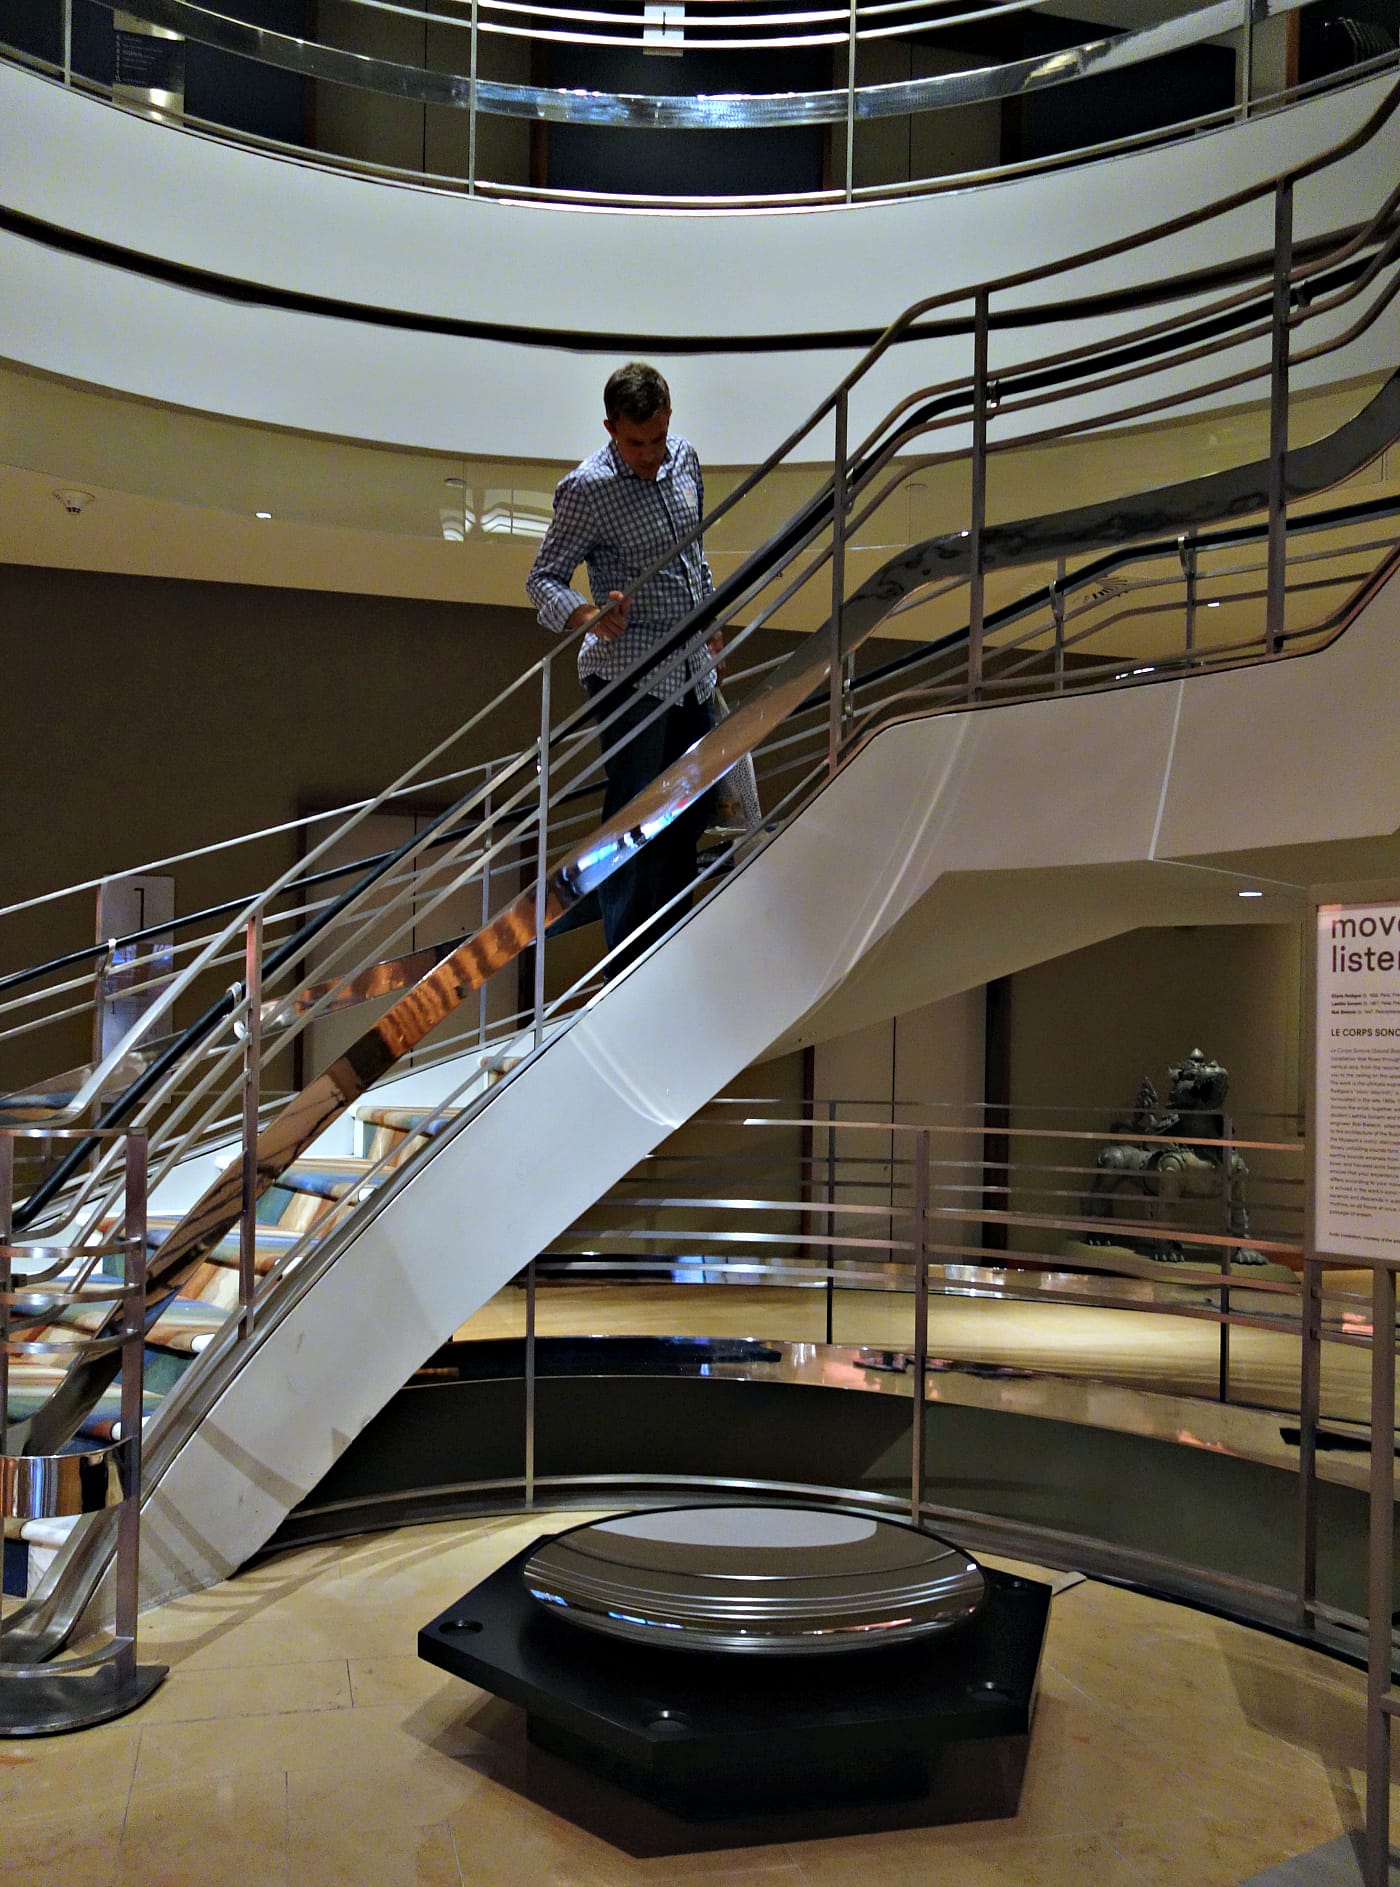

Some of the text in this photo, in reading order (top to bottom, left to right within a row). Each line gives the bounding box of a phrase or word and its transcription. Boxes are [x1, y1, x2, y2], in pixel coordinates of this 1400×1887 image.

[1331, 915, 1400, 939] mov
[1332, 945, 1400, 973] liste
[1331, 1028, 1341, 1037] LE
[1342, 1028, 1373, 1037] CORPS
